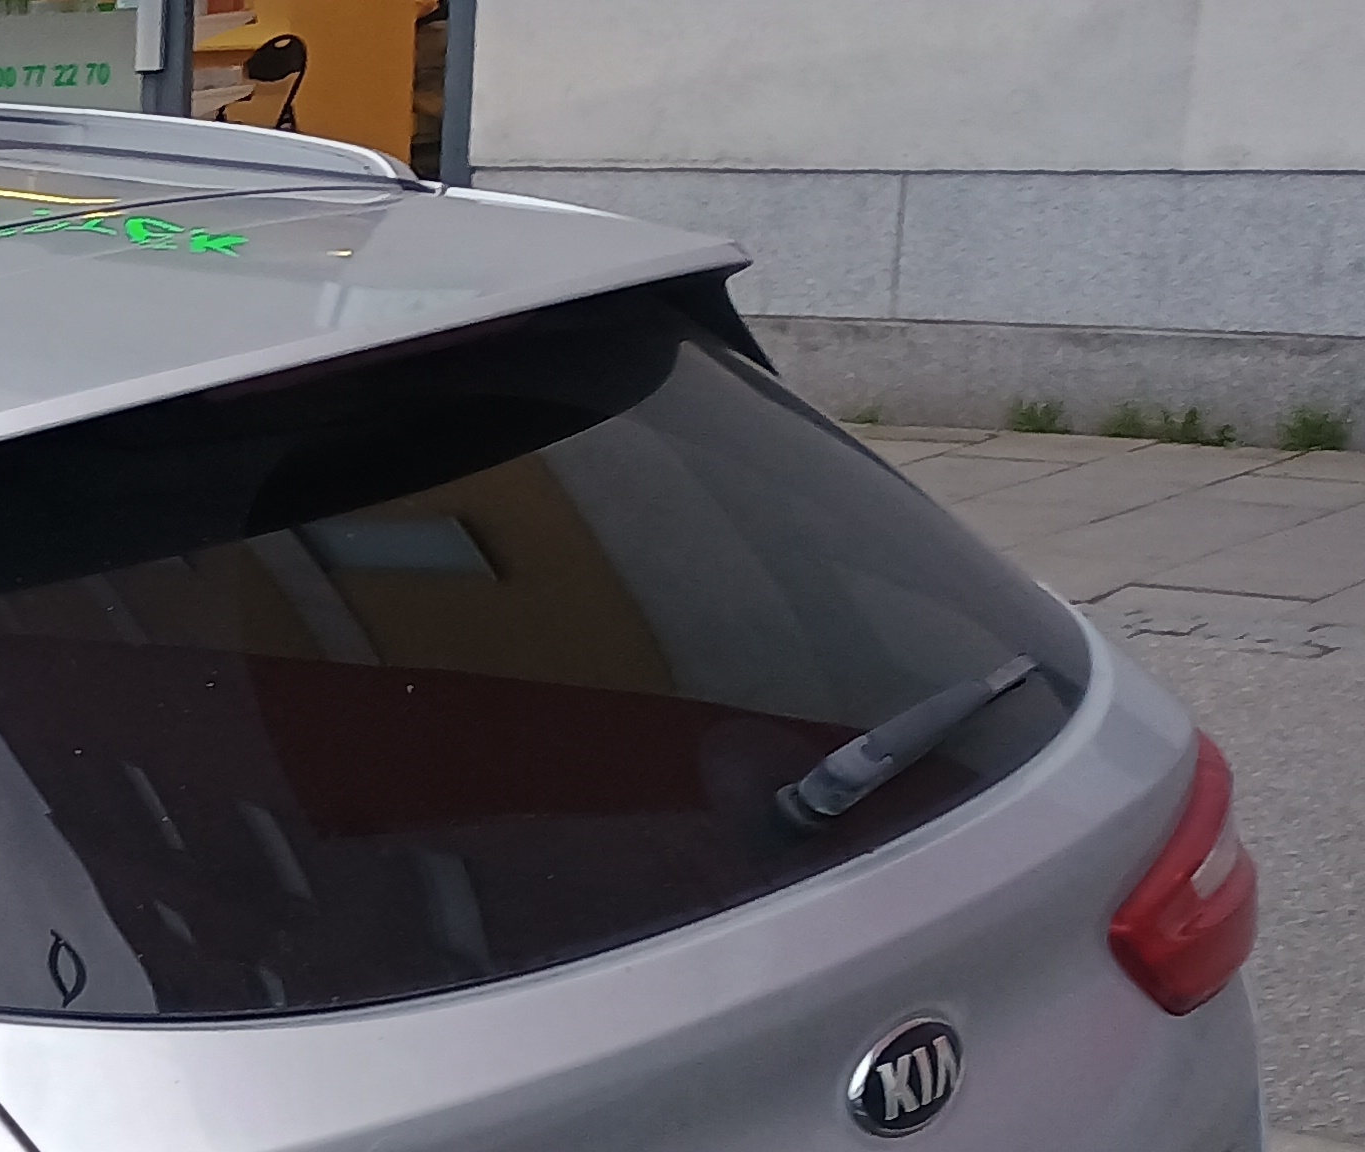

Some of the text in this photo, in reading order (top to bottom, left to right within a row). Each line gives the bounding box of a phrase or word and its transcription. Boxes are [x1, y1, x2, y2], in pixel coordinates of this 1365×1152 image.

[23, 64, 47, 87] 77
[52, 63, 79, 87] 22
[86, 62, 111, 86] 70
[876, 1035, 959, 1121] KIA
